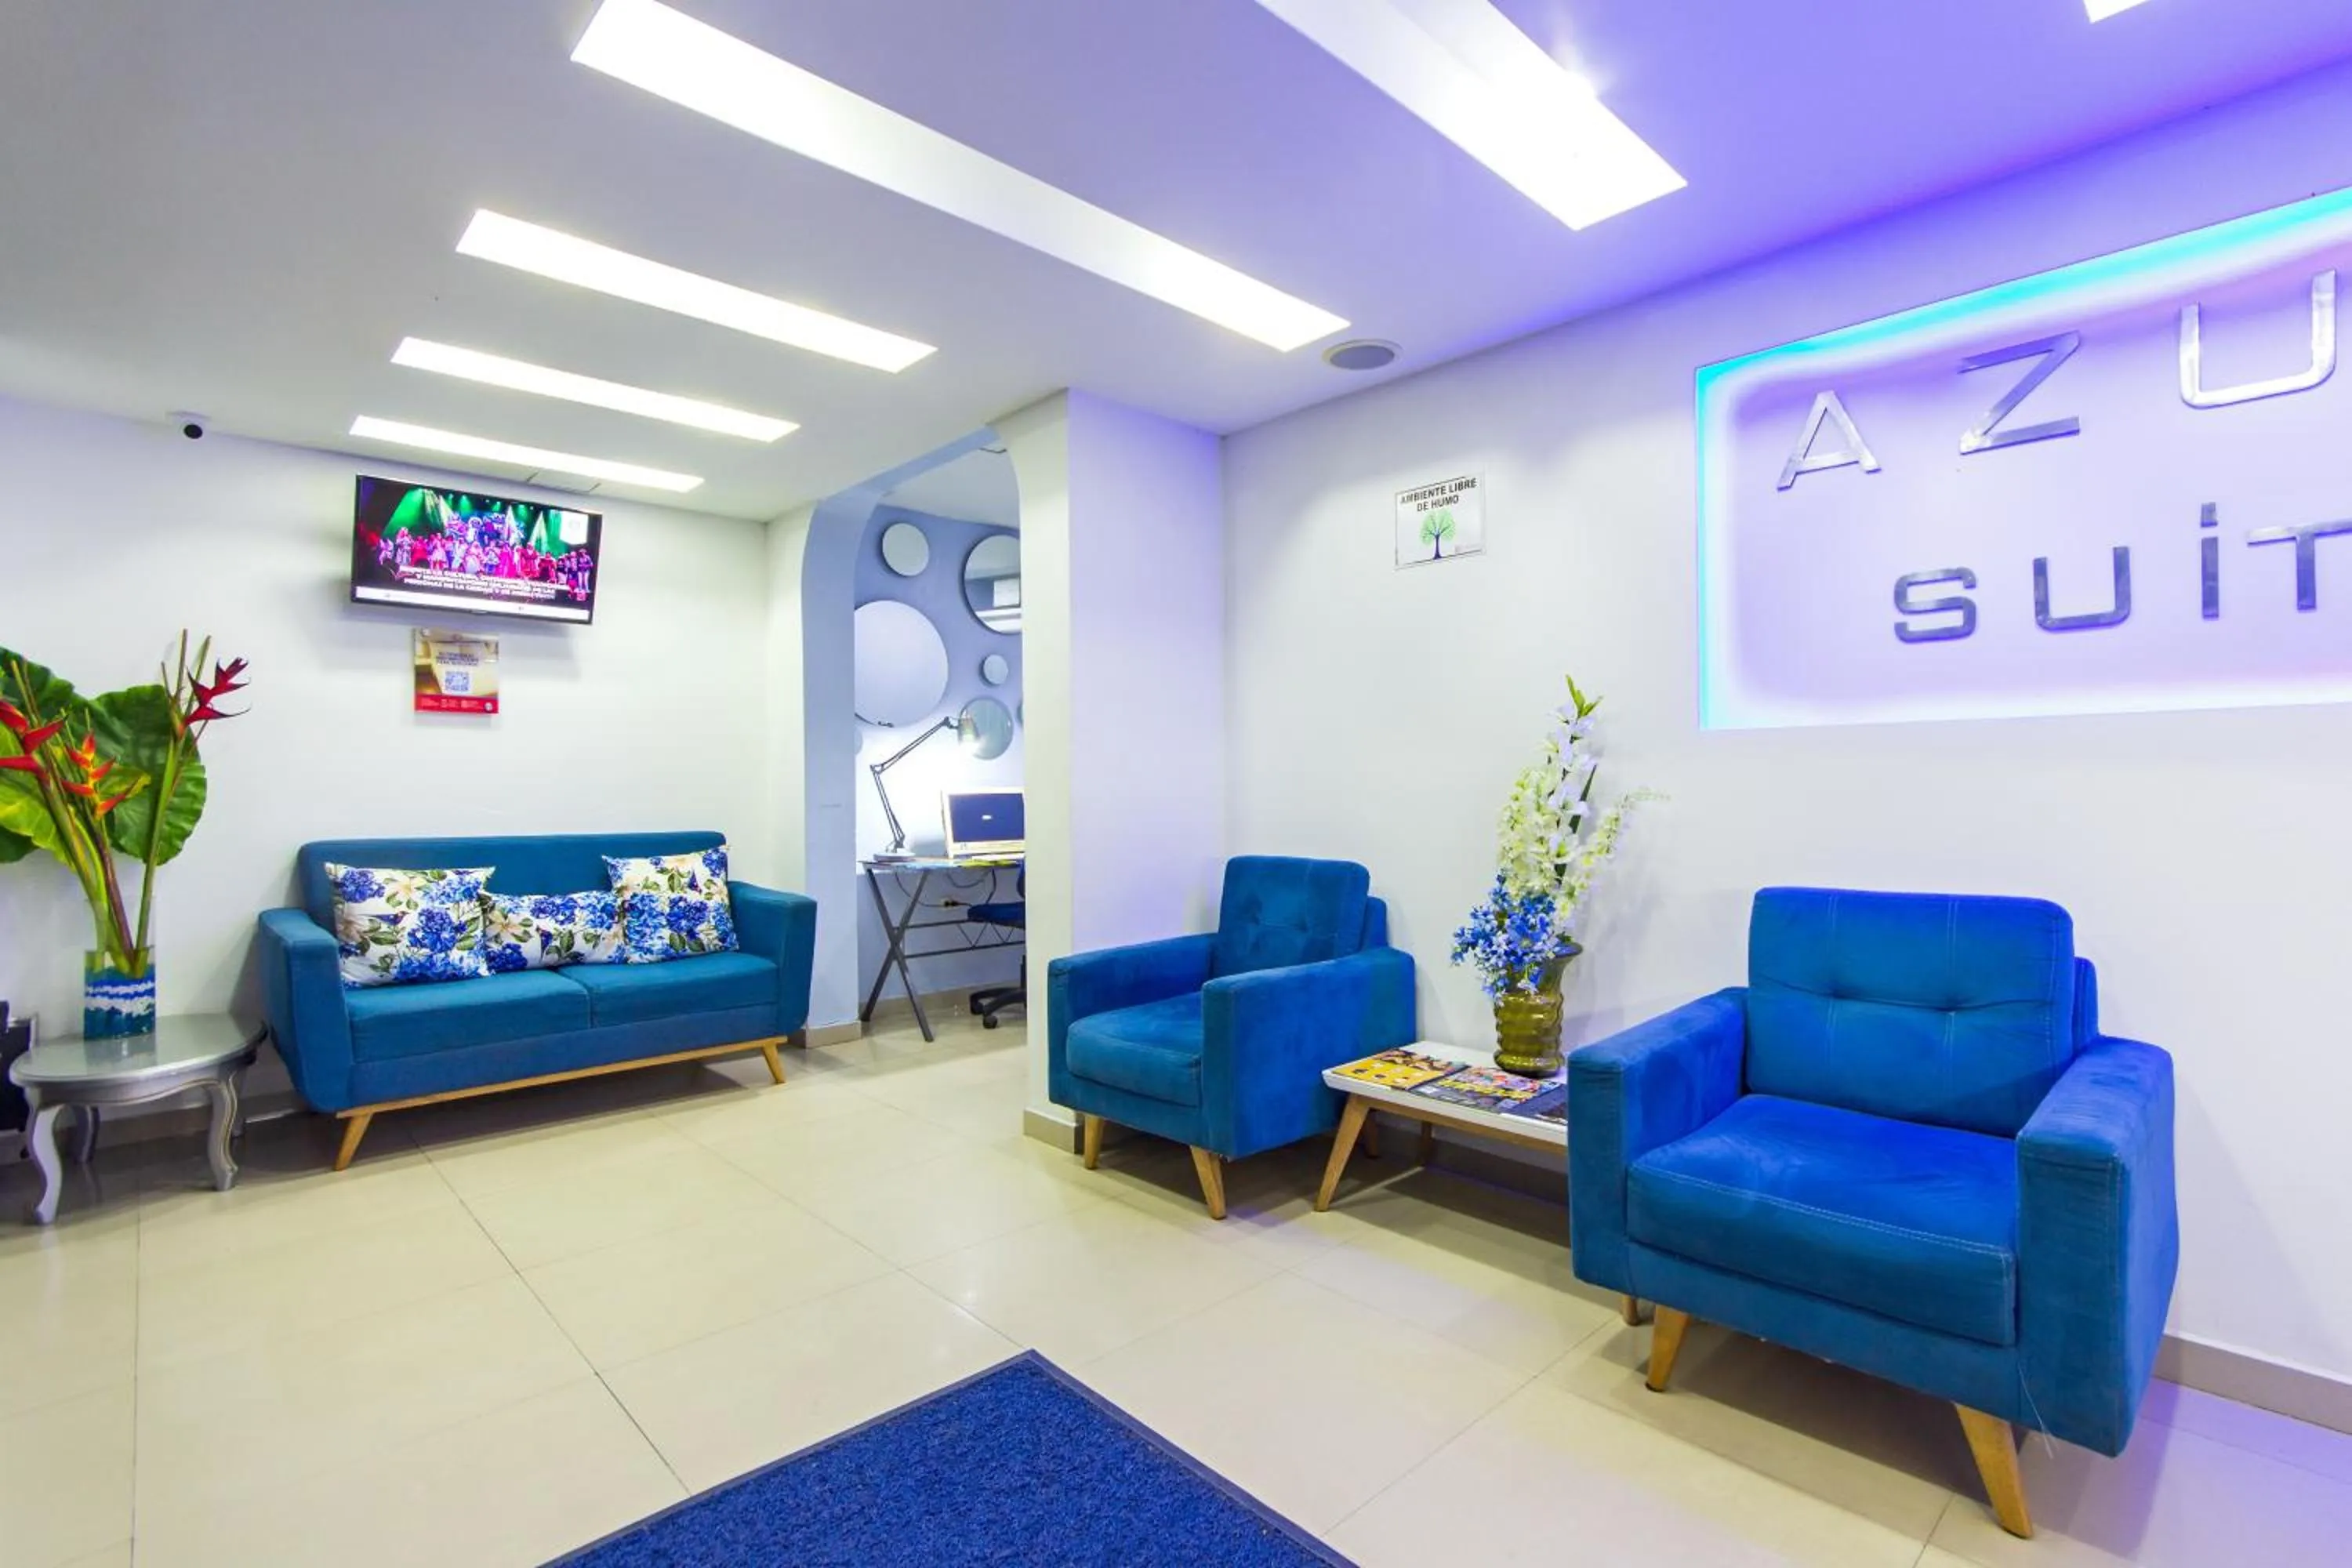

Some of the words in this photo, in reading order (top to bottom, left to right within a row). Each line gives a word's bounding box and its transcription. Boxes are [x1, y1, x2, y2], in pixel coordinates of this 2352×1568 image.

[1777, 268, 2337, 492] AZU
[1401, 486, 1446, 503] AMBIENTE
[1449, 478, 1477, 493] LIBRE
[1417, 503, 1428, 511] DE
[1432, 495, 1459, 510] HUMO
